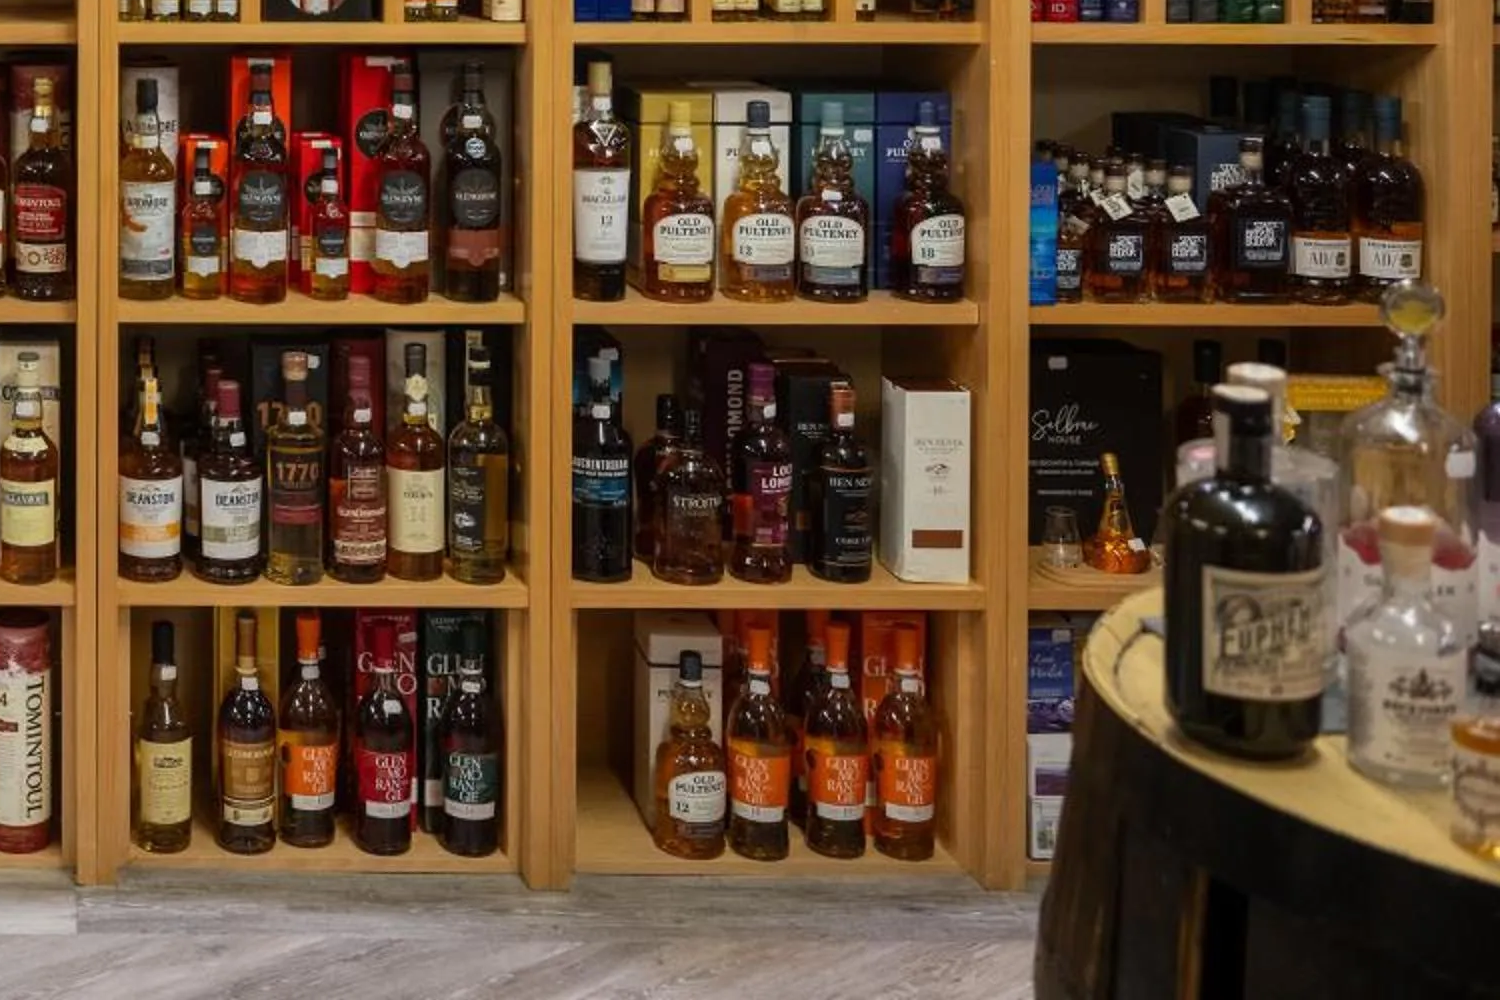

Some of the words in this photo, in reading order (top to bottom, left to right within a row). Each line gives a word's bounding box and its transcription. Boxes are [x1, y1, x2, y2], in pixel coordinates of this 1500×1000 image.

[677, 217, 701, 227] OLD
[755, 217, 779, 227] OLD
[818, 219, 843, 230] OLD
[803, 228, 859, 240] PULTENEY
[276, 463, 319, 482] 1770
[829, 477, 853, 488] BEN
[127, 492, 174, 506] DEANSTON
[26, 676, 45, 819] TOMINTOUL
[302, 746, 331, 758] GLEN
[375, 754, 407, 766] GLEN
[449, 754, 480, 766] GLEN
[735, 757, 766, 769] GLEN
[825, 757, 859, 769] GLEN
[896, 758, 929, 769] GLEN
[692, 774, 716, 784] OLD
[676, 802, 691, 814] 12
